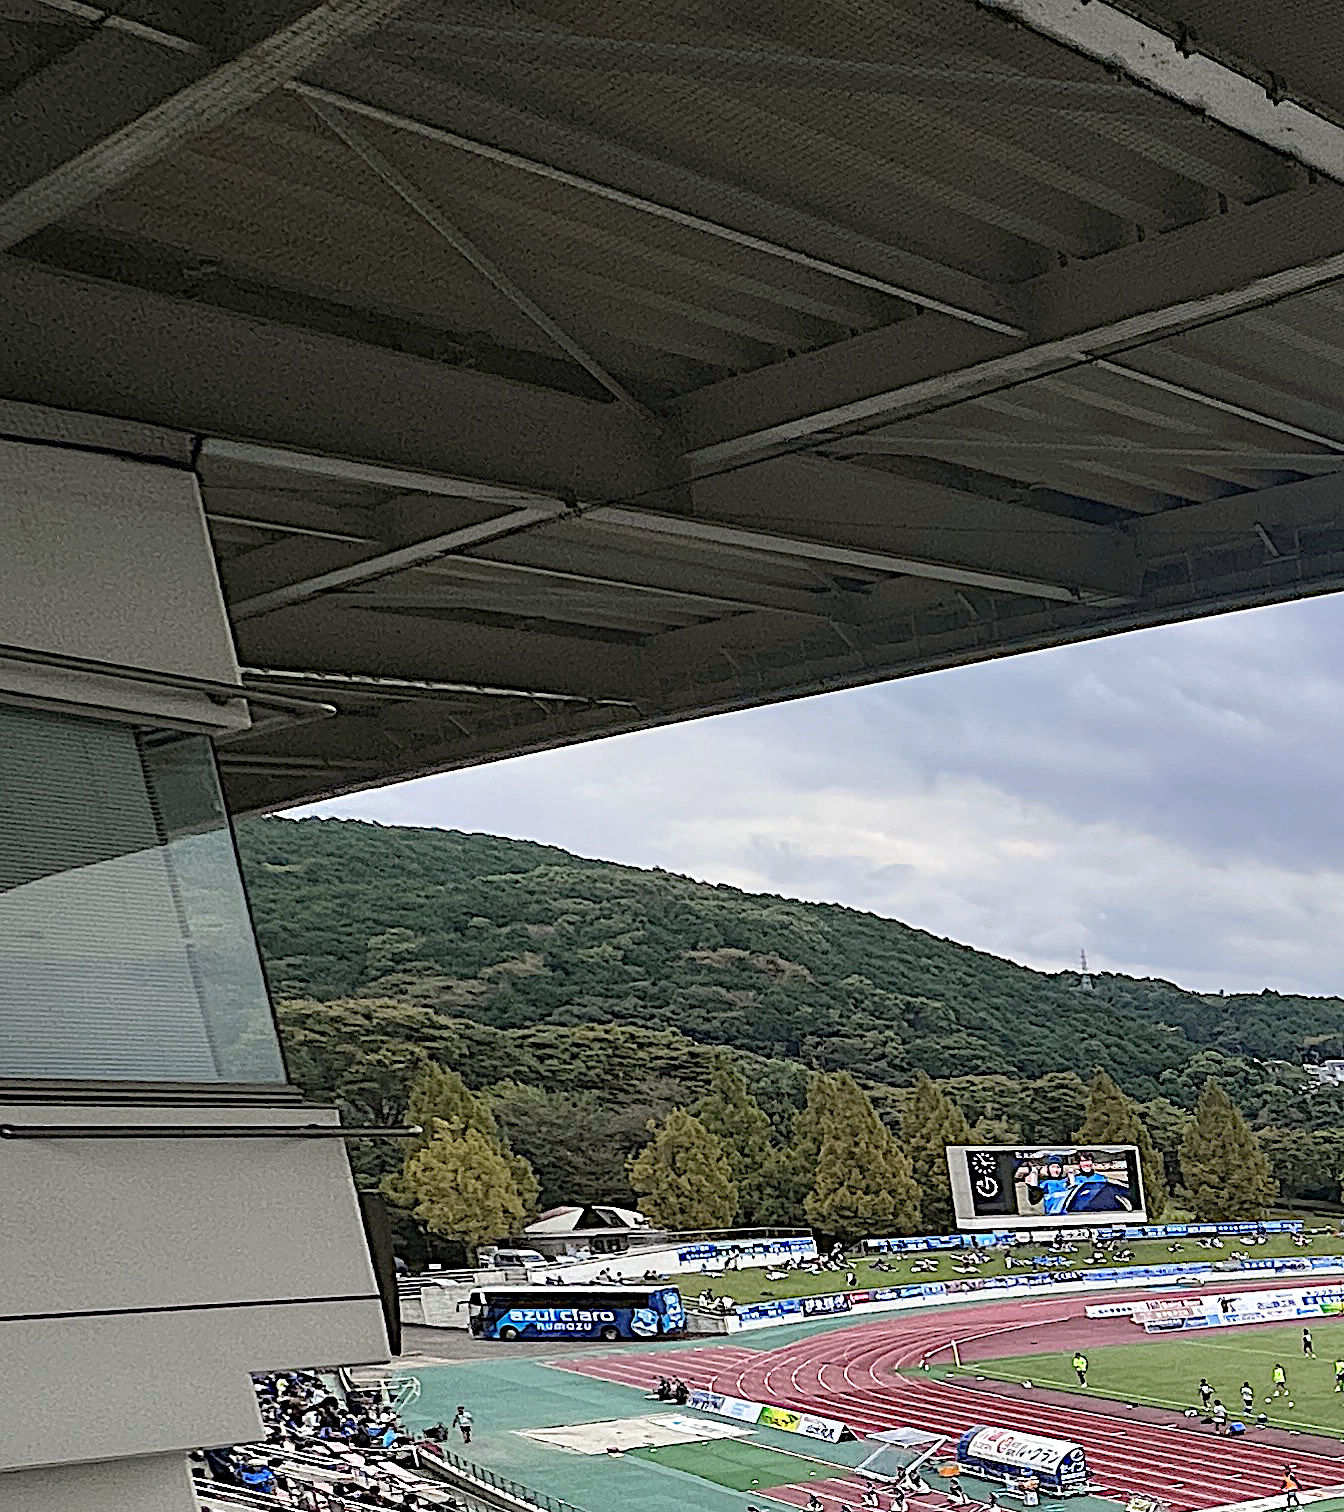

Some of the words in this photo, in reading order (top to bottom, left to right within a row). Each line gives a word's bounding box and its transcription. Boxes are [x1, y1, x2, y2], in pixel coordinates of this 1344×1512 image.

[510, 1308, 556, 1322] azul
[559, 1308, 615, 1322] claro
[536, 1322, 592, 1331] numazu
